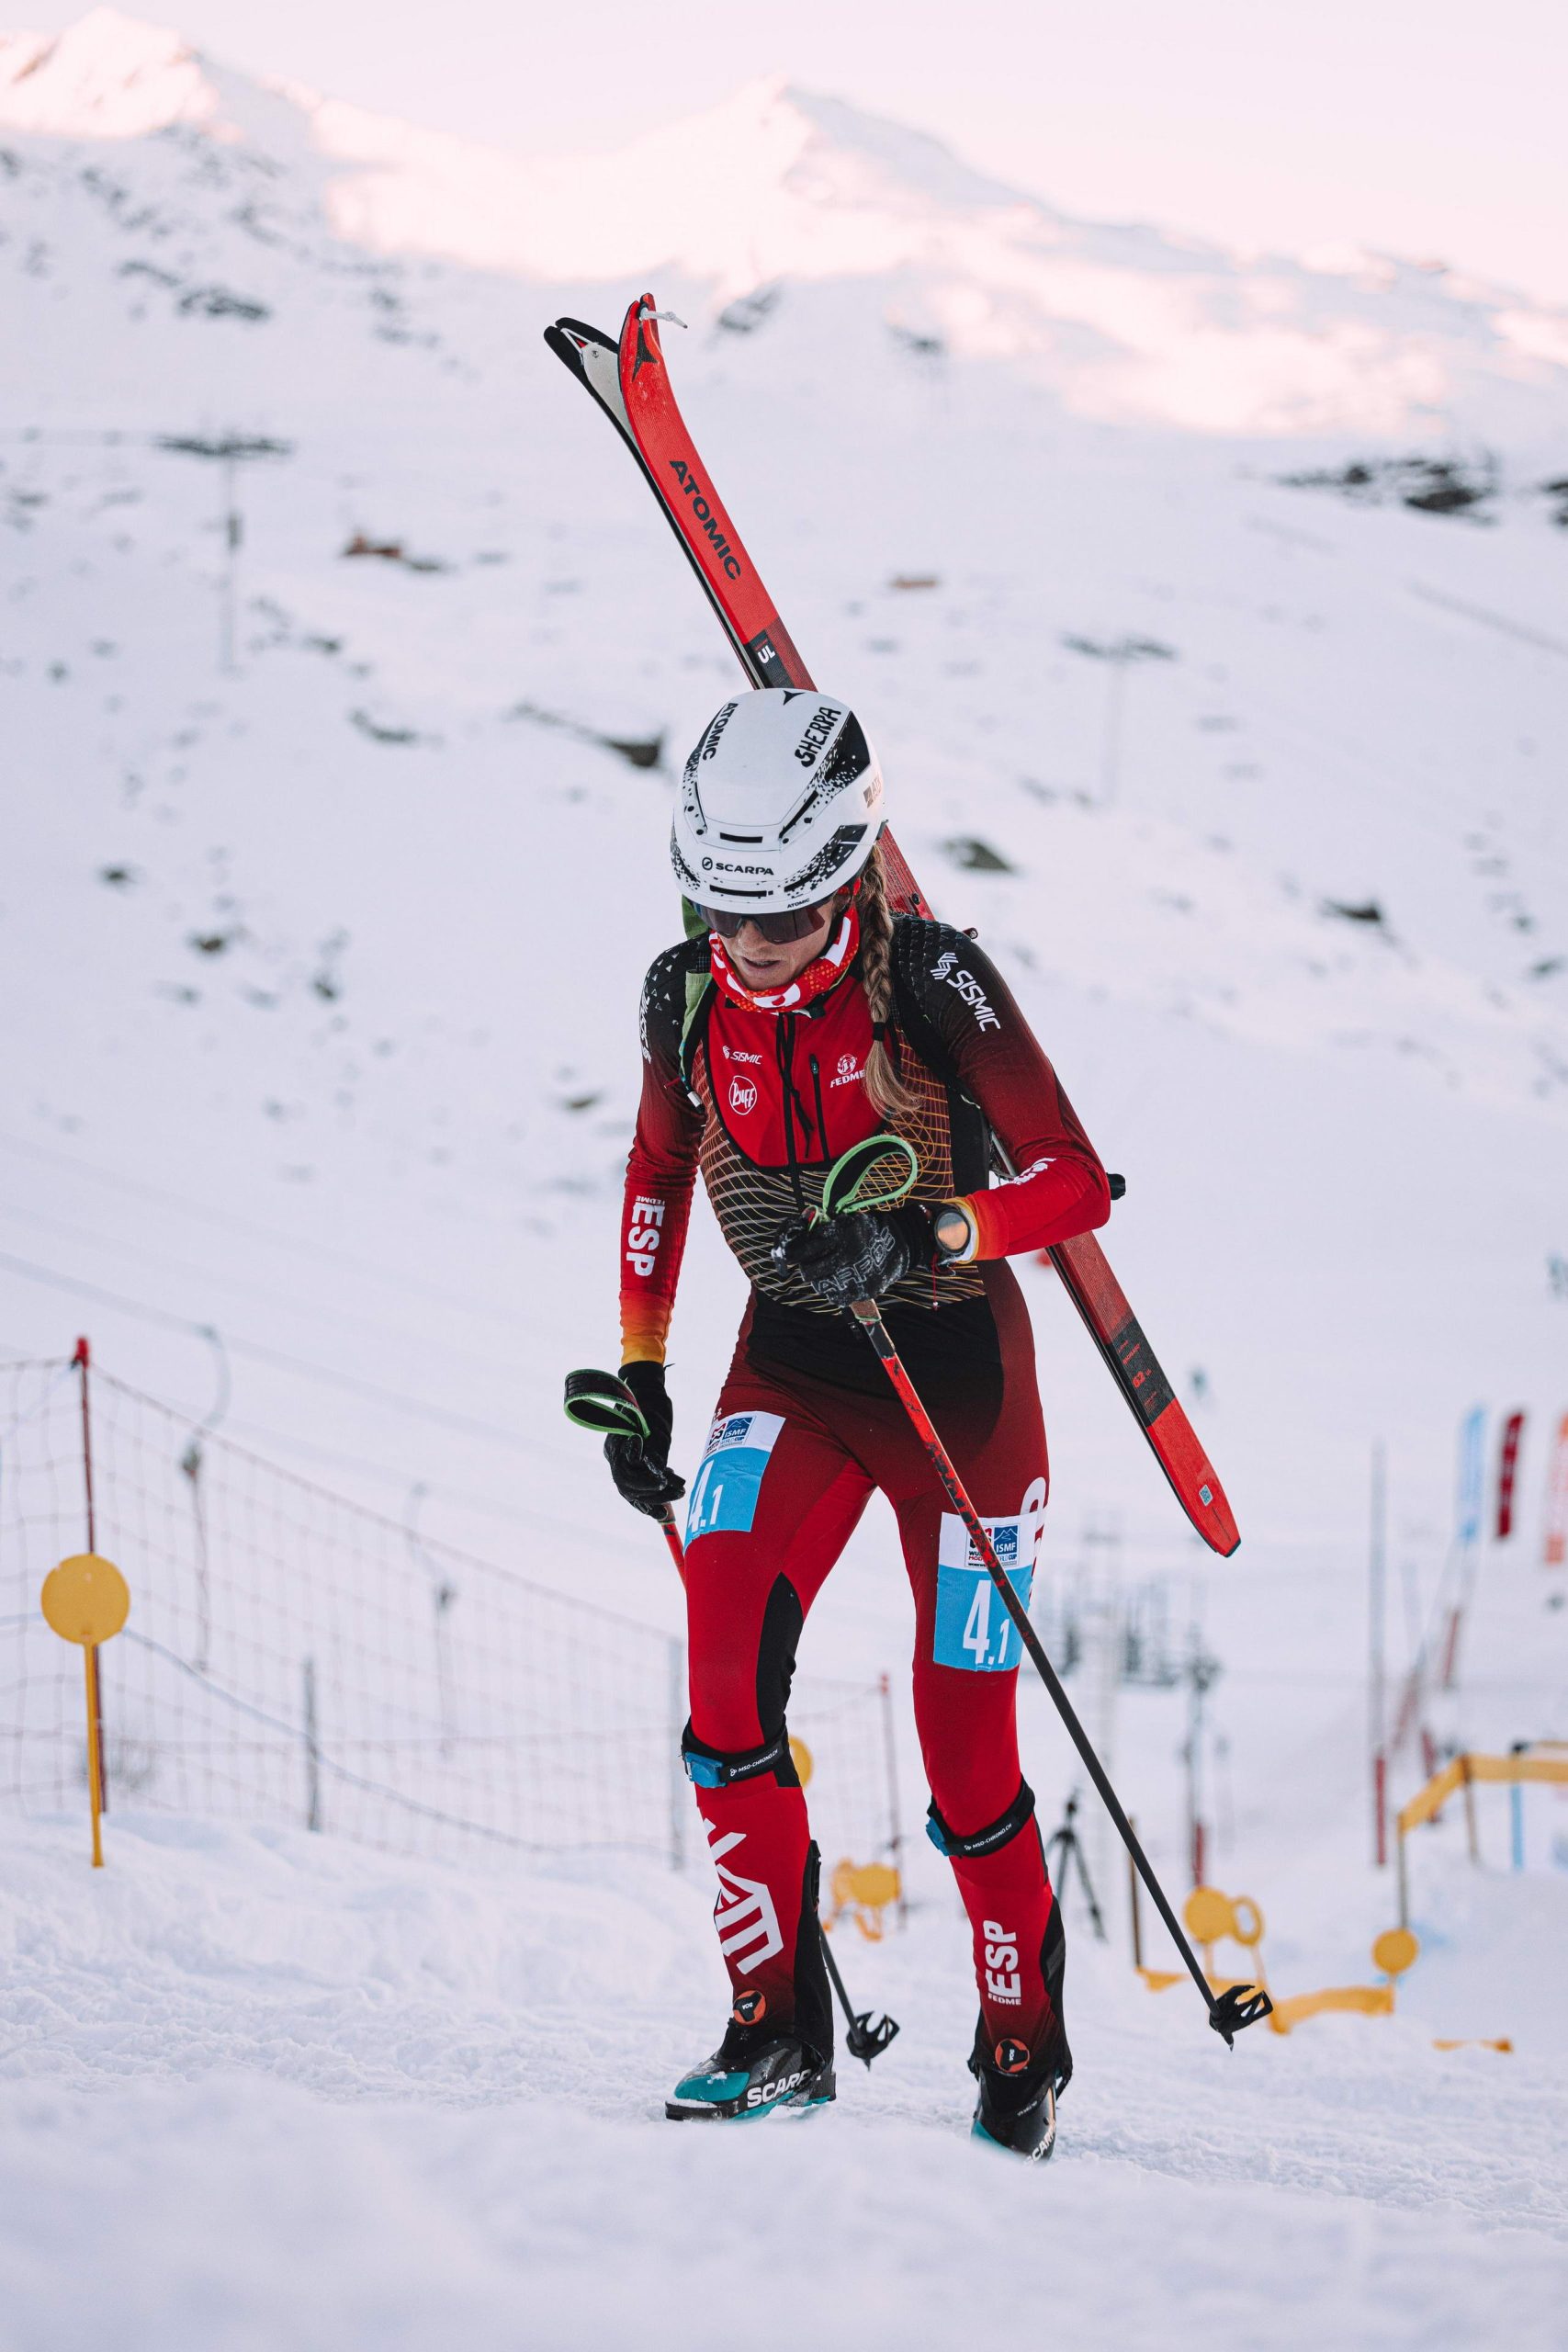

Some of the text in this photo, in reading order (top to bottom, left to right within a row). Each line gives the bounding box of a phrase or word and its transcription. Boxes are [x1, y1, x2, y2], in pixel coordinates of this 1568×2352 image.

[669, 459, 741, 581] ATOMIC
[757, 645, 776, 664] UL
[702, 702, 739, 761] ATOMIC
[794, 706, 841, 768] SHERPA
[716, 862, 774, 876] SCARPA
[786, 898, 810, 909] ATOMIC
[945, 969, 1001, 1032] SISMIC
[730, 1050, 763, 1065] SISMIC
[829, 1069, 866, 1089] FEDME
[626, 1202, 666, 1277] ESP
[725, 1428, 746, 1438] ISMF
[687, 1460, 724, 1533] 4.1
[996, 1543, 1016, 1553] ISMF
[963, 1579, 1010, 1665] 4.1
[983, 1920, 1021, 1998] ESP
[987, 1993, 1022, 2006] FEDME
[747, 2068, 821, 2109] SCARP
